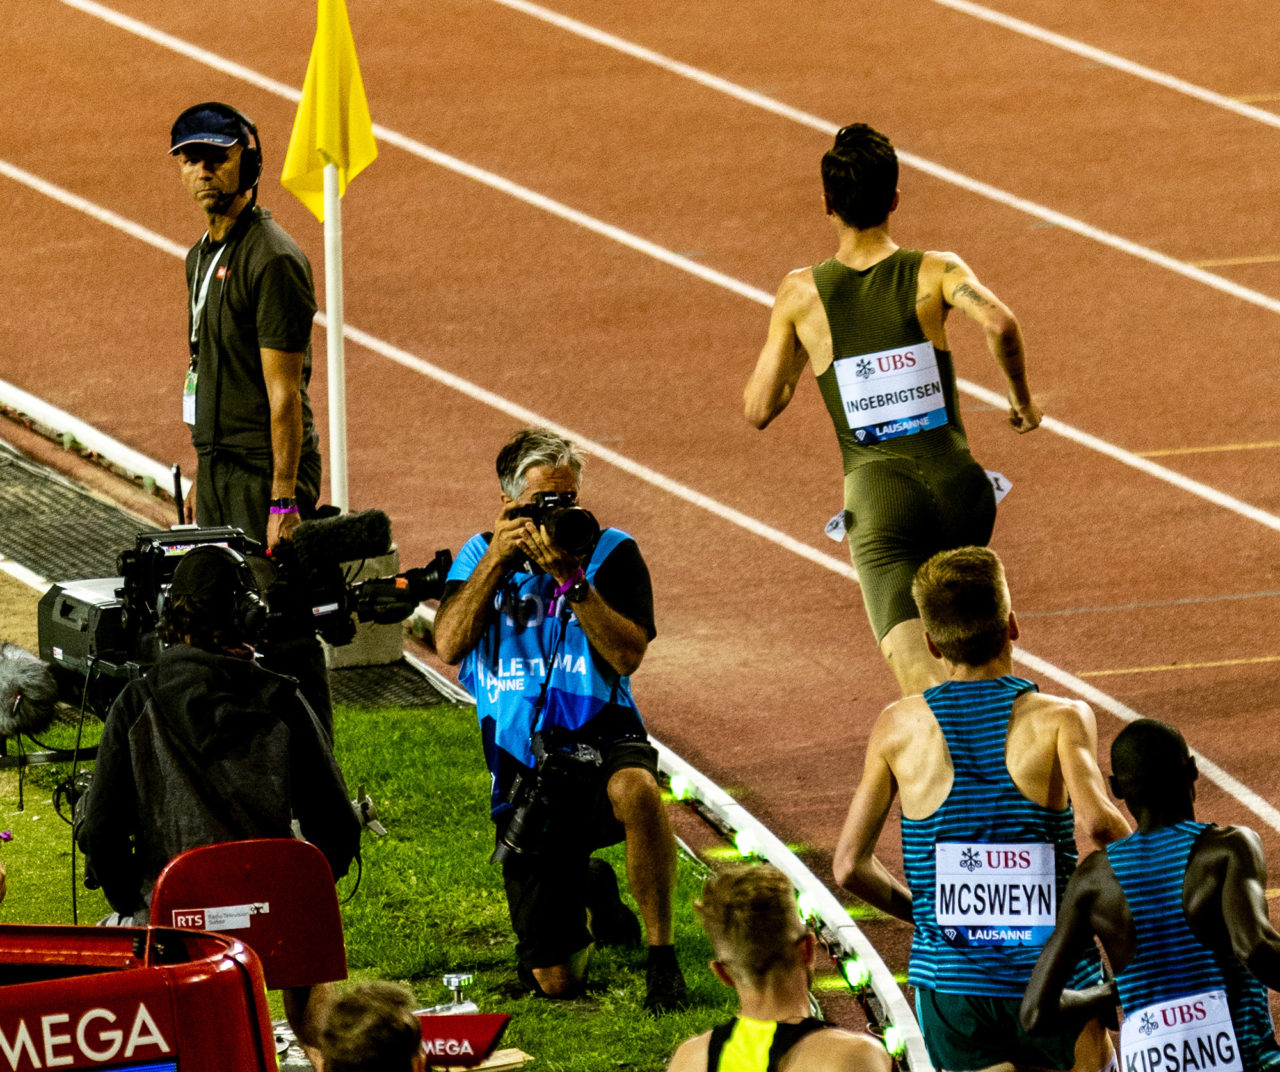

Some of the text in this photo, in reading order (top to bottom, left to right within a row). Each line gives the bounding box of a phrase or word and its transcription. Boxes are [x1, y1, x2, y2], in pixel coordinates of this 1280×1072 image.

[876, 351, 917, 373] UBS
[846, 381, 942, 414] INGEBRIGTSEN
[875, 416, 930, 436] LAUSANNE
[985, 850, 1031, 869] UBS
[940, 883, 1051, 915] MCSWEYN
[177, 915, 203, 927] RTS
[968, 929, 1032, 940] LAUSANNE
[1160, 1001, 1207, 1028] UBS
